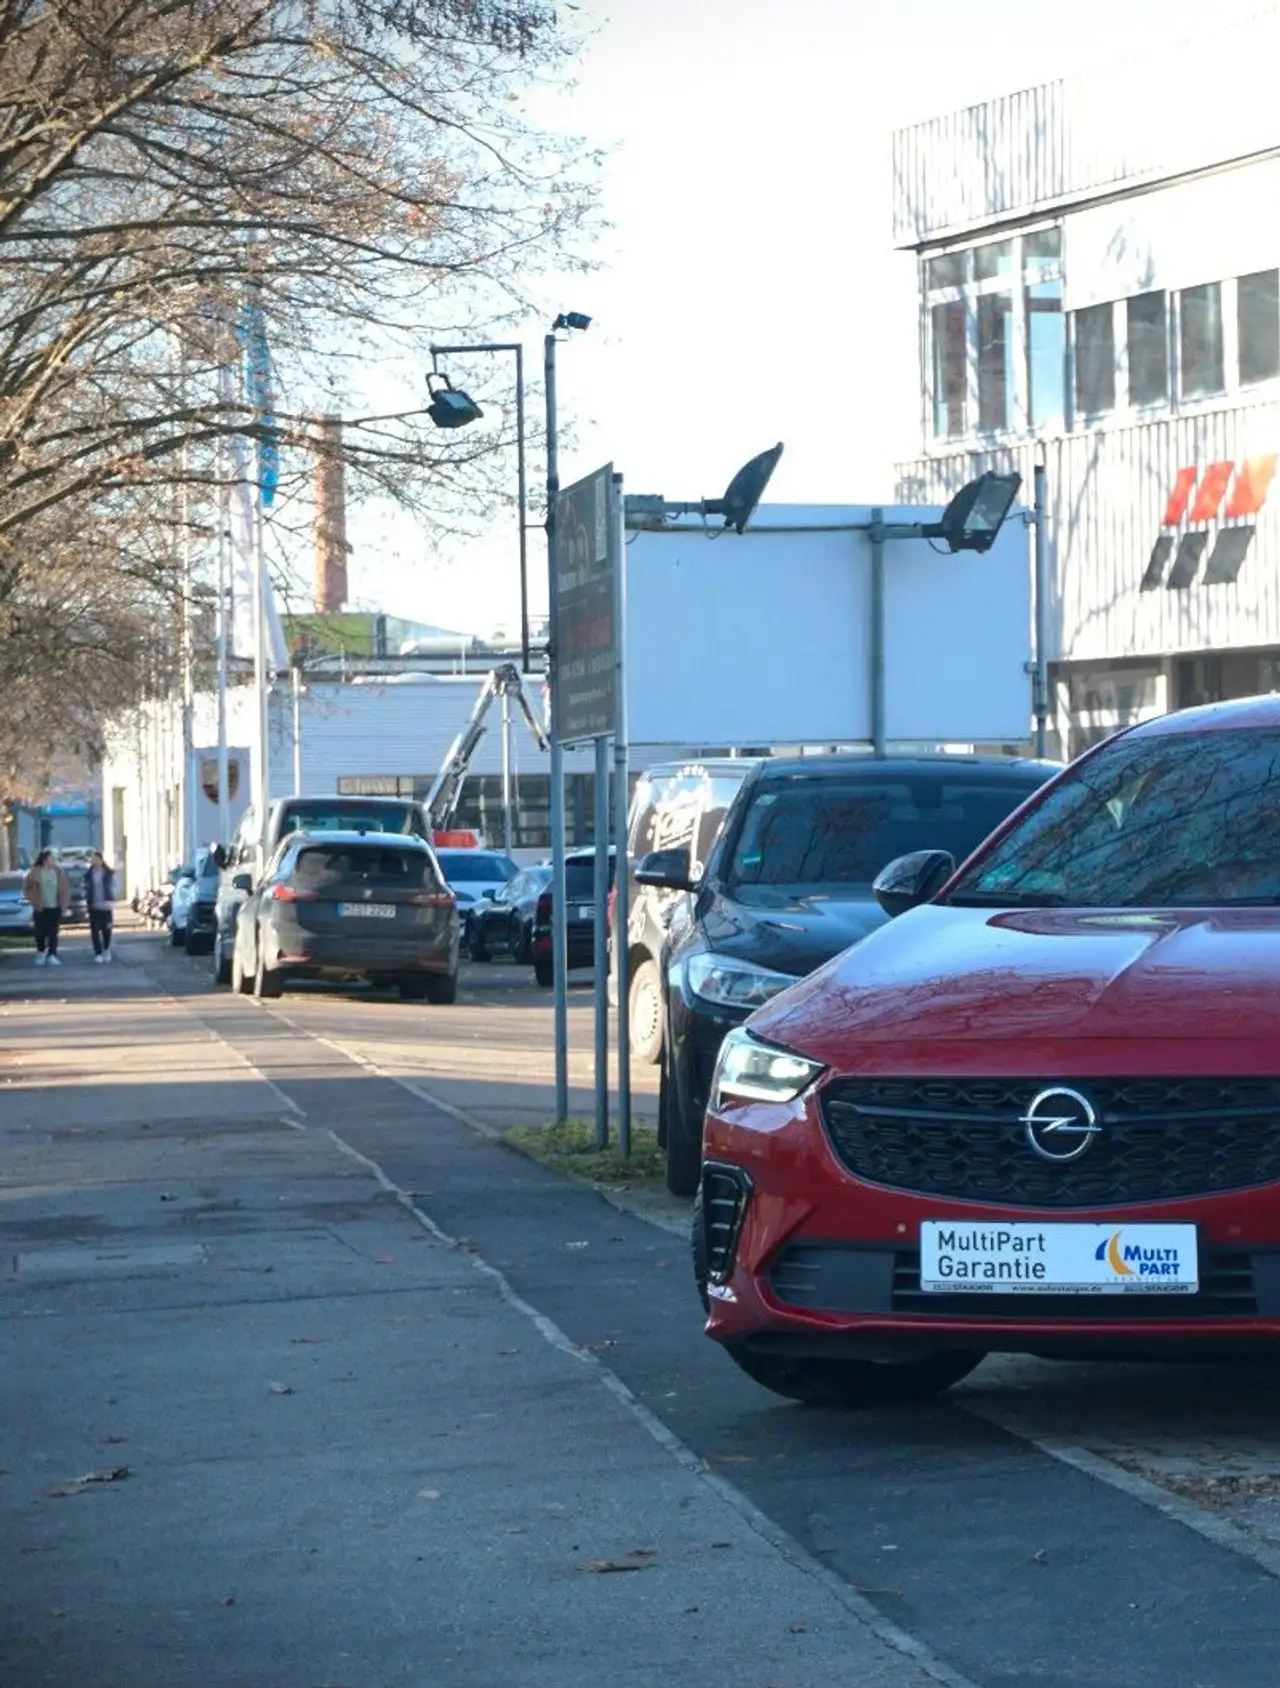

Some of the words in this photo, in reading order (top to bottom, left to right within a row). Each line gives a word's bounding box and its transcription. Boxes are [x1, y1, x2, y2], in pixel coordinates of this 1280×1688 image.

[938, 1230, 1046, 1252] MultiPart
[1124, 1245, 1178, 1261] MULTI
[938, 1255, 1046, 1279] Garantie
[1140, 1262, 1181, 1275] PART
